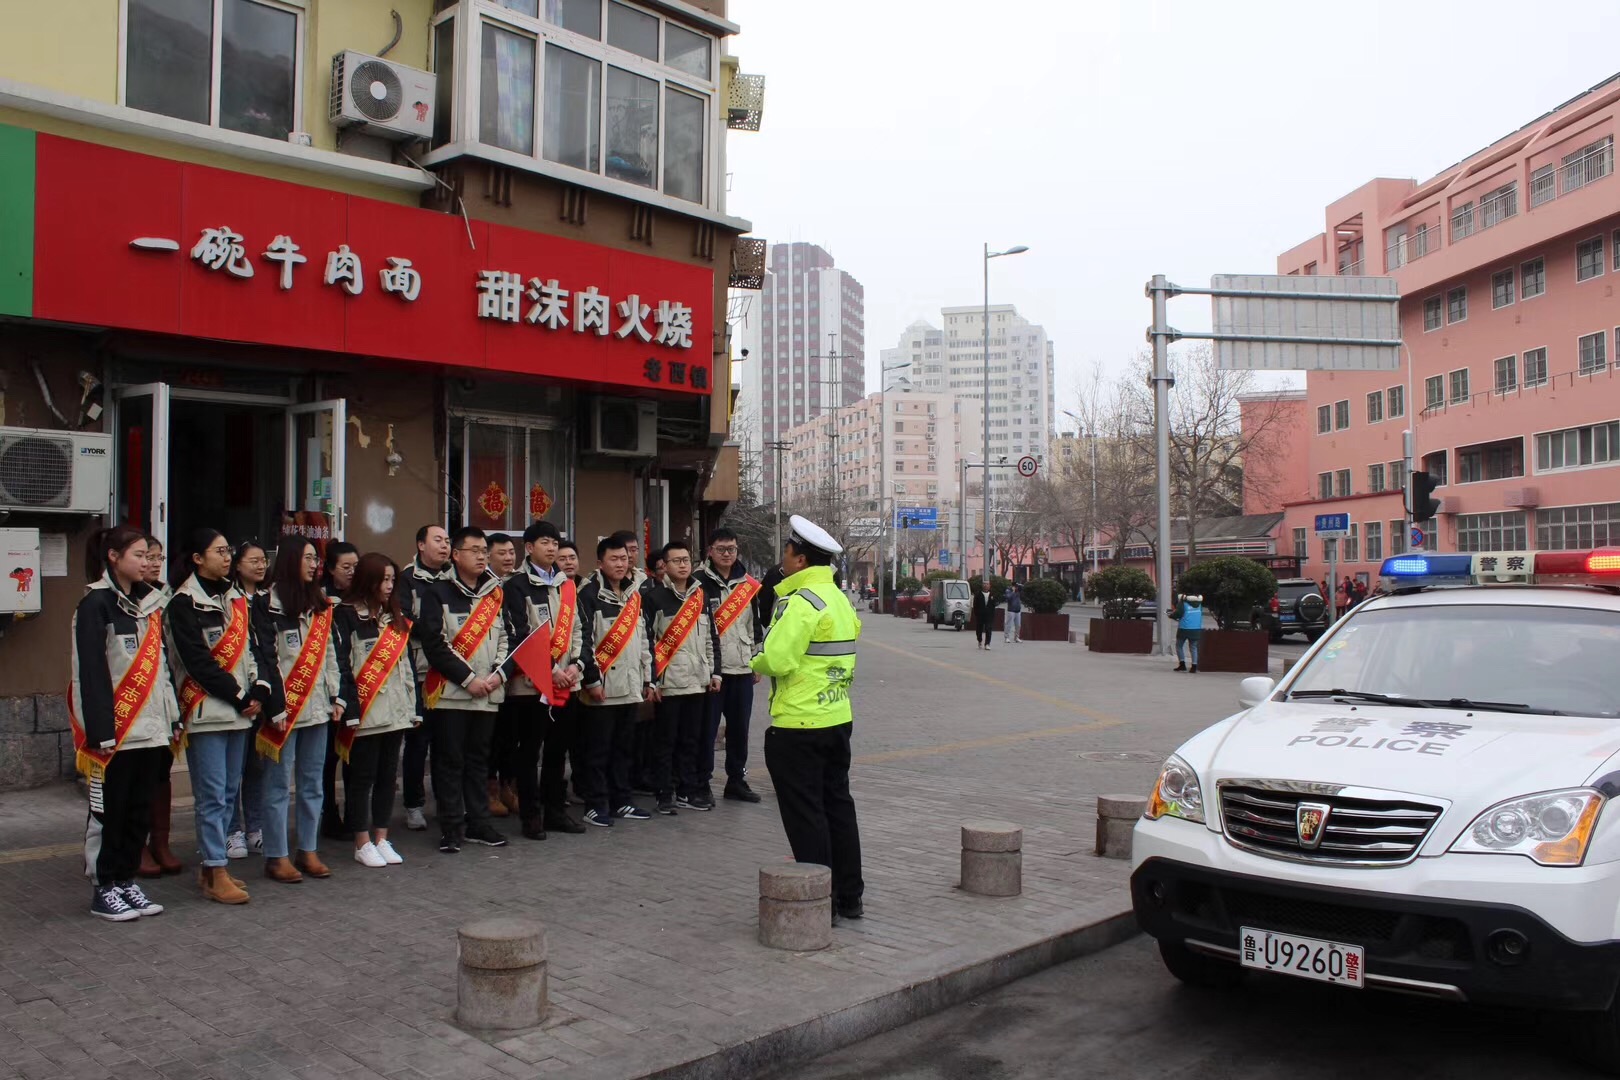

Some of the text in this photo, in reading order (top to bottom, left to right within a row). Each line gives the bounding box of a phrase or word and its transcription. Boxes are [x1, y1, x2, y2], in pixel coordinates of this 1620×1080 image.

[129, 226, 421, 300] 一碗牛肉面
[476, 270, 692, 348] 甜沫肉火烧
[1022, 461, 1033, 471] 60
[1480, 556, 1525, 572] 警察
[714, 582, 753, 628] 青岛水务青年
[1310, 717, 1473, 740] 警察
[1287, 735, 1450, 756] POLICE
